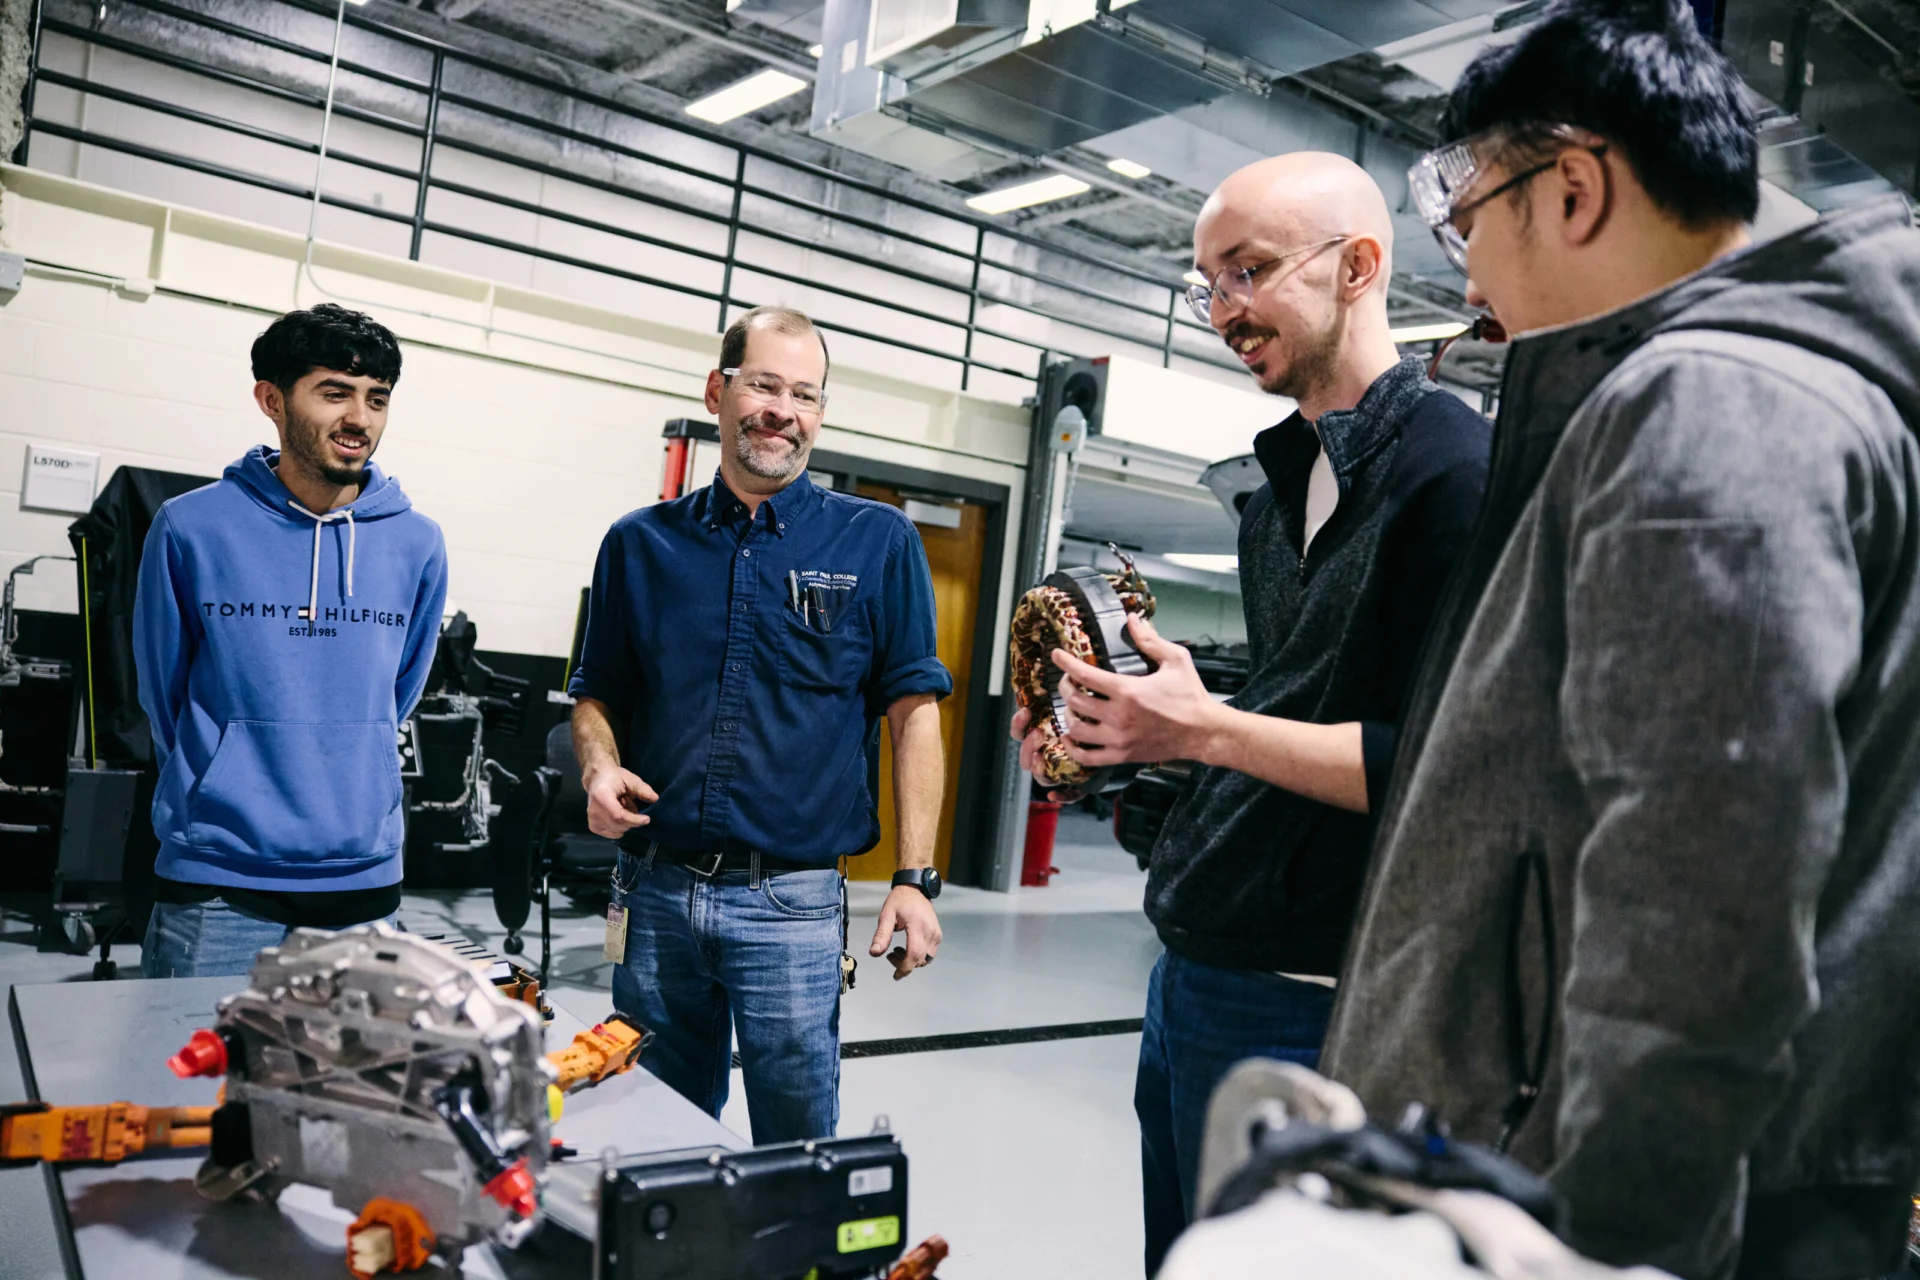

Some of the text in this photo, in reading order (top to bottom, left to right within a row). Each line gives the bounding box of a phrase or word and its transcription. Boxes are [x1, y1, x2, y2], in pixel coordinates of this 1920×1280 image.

[833, 573, 858, 582] COLLEGE
[203, 602, 405, 627] TOMMY HILFIGER
[313, 627, 337, 637] 1985
